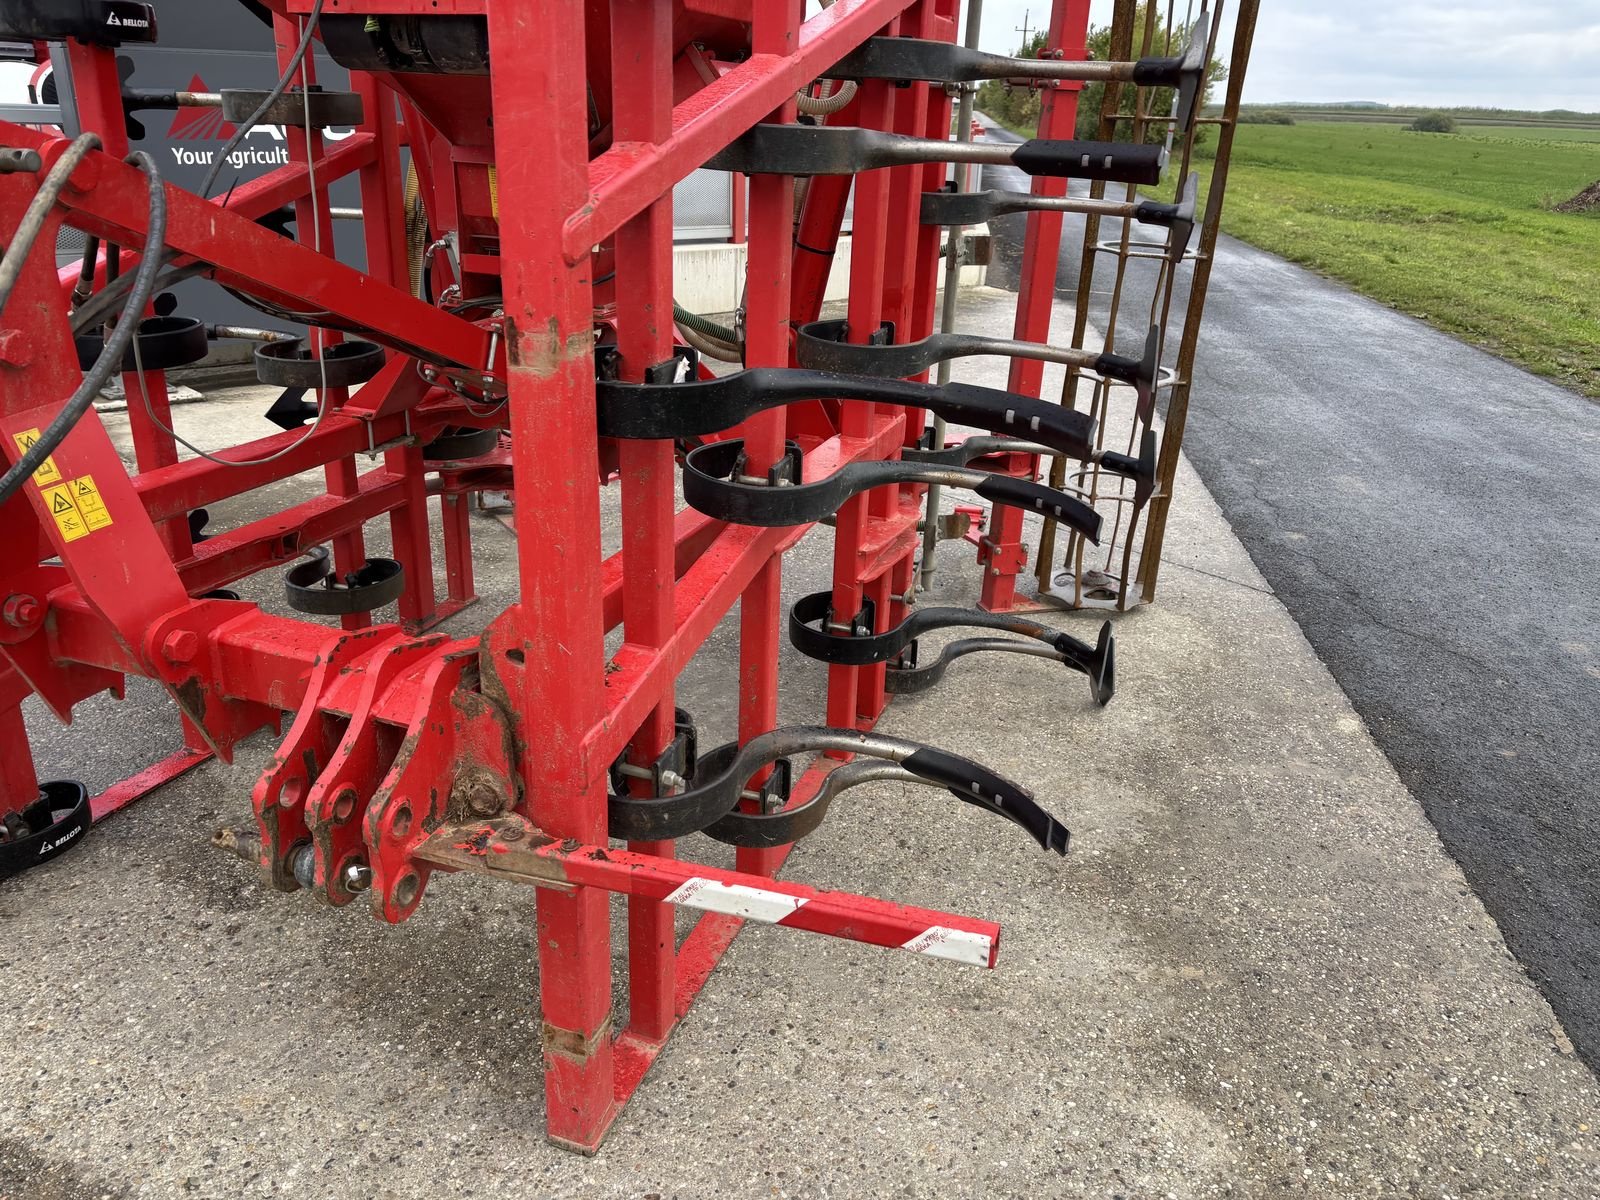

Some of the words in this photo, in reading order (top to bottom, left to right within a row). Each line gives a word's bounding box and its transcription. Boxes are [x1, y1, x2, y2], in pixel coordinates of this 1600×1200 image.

[123, 18, 149, 28] BELLOTA
[171, 147, 214, 165] Your
[55, 825, 82, 848] BELLOTA
